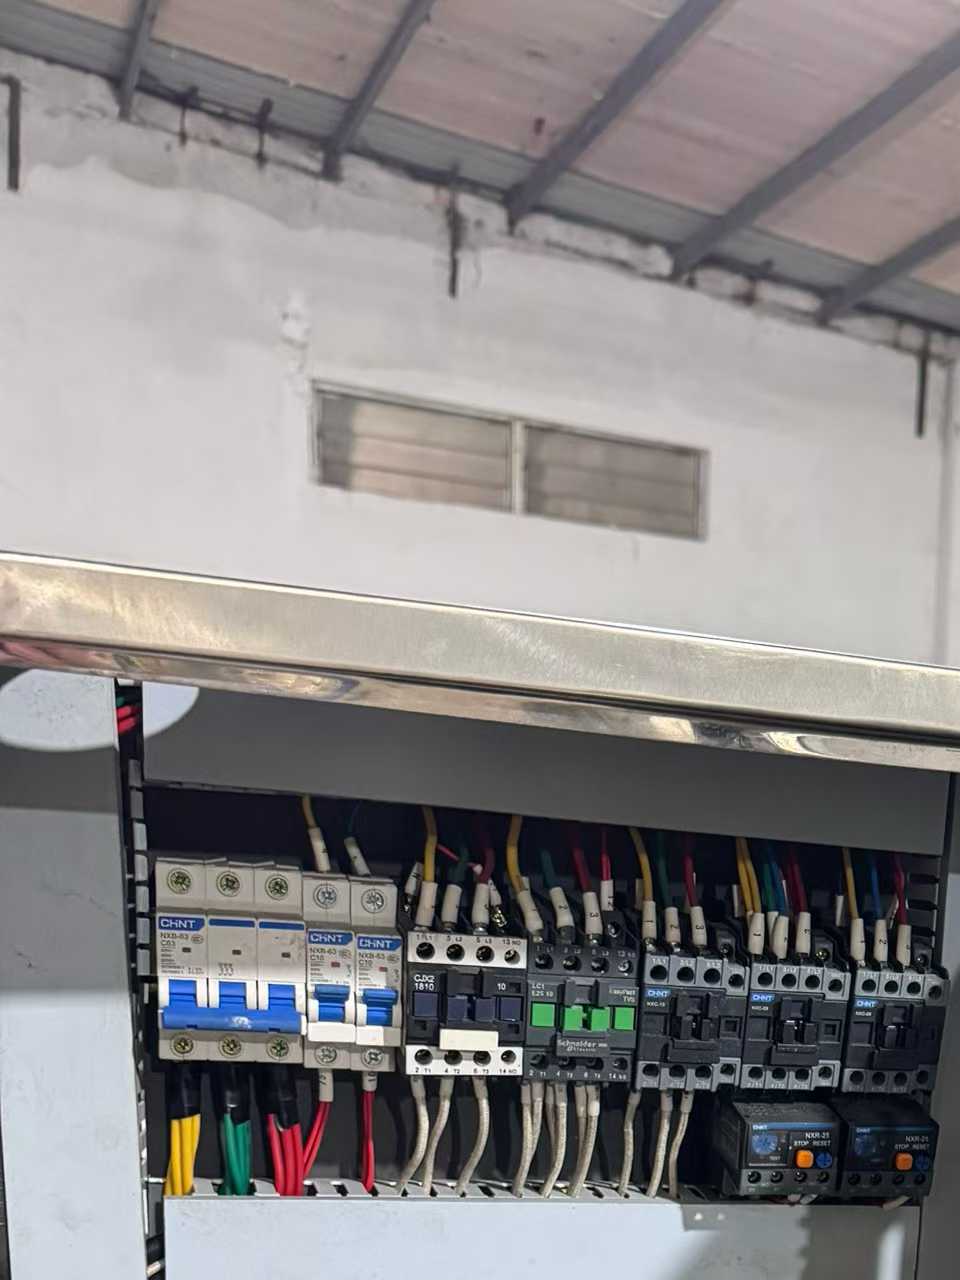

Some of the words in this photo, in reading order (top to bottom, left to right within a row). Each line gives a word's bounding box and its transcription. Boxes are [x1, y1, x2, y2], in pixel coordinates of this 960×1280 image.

[160, 919, 196, 929] CHNT
[310, 933, 344, 942] CHNT
[359, 938, 393, 948] CHNT
[414, 983, 434, 991] 1810
[497, 983, 507, 991] 10
